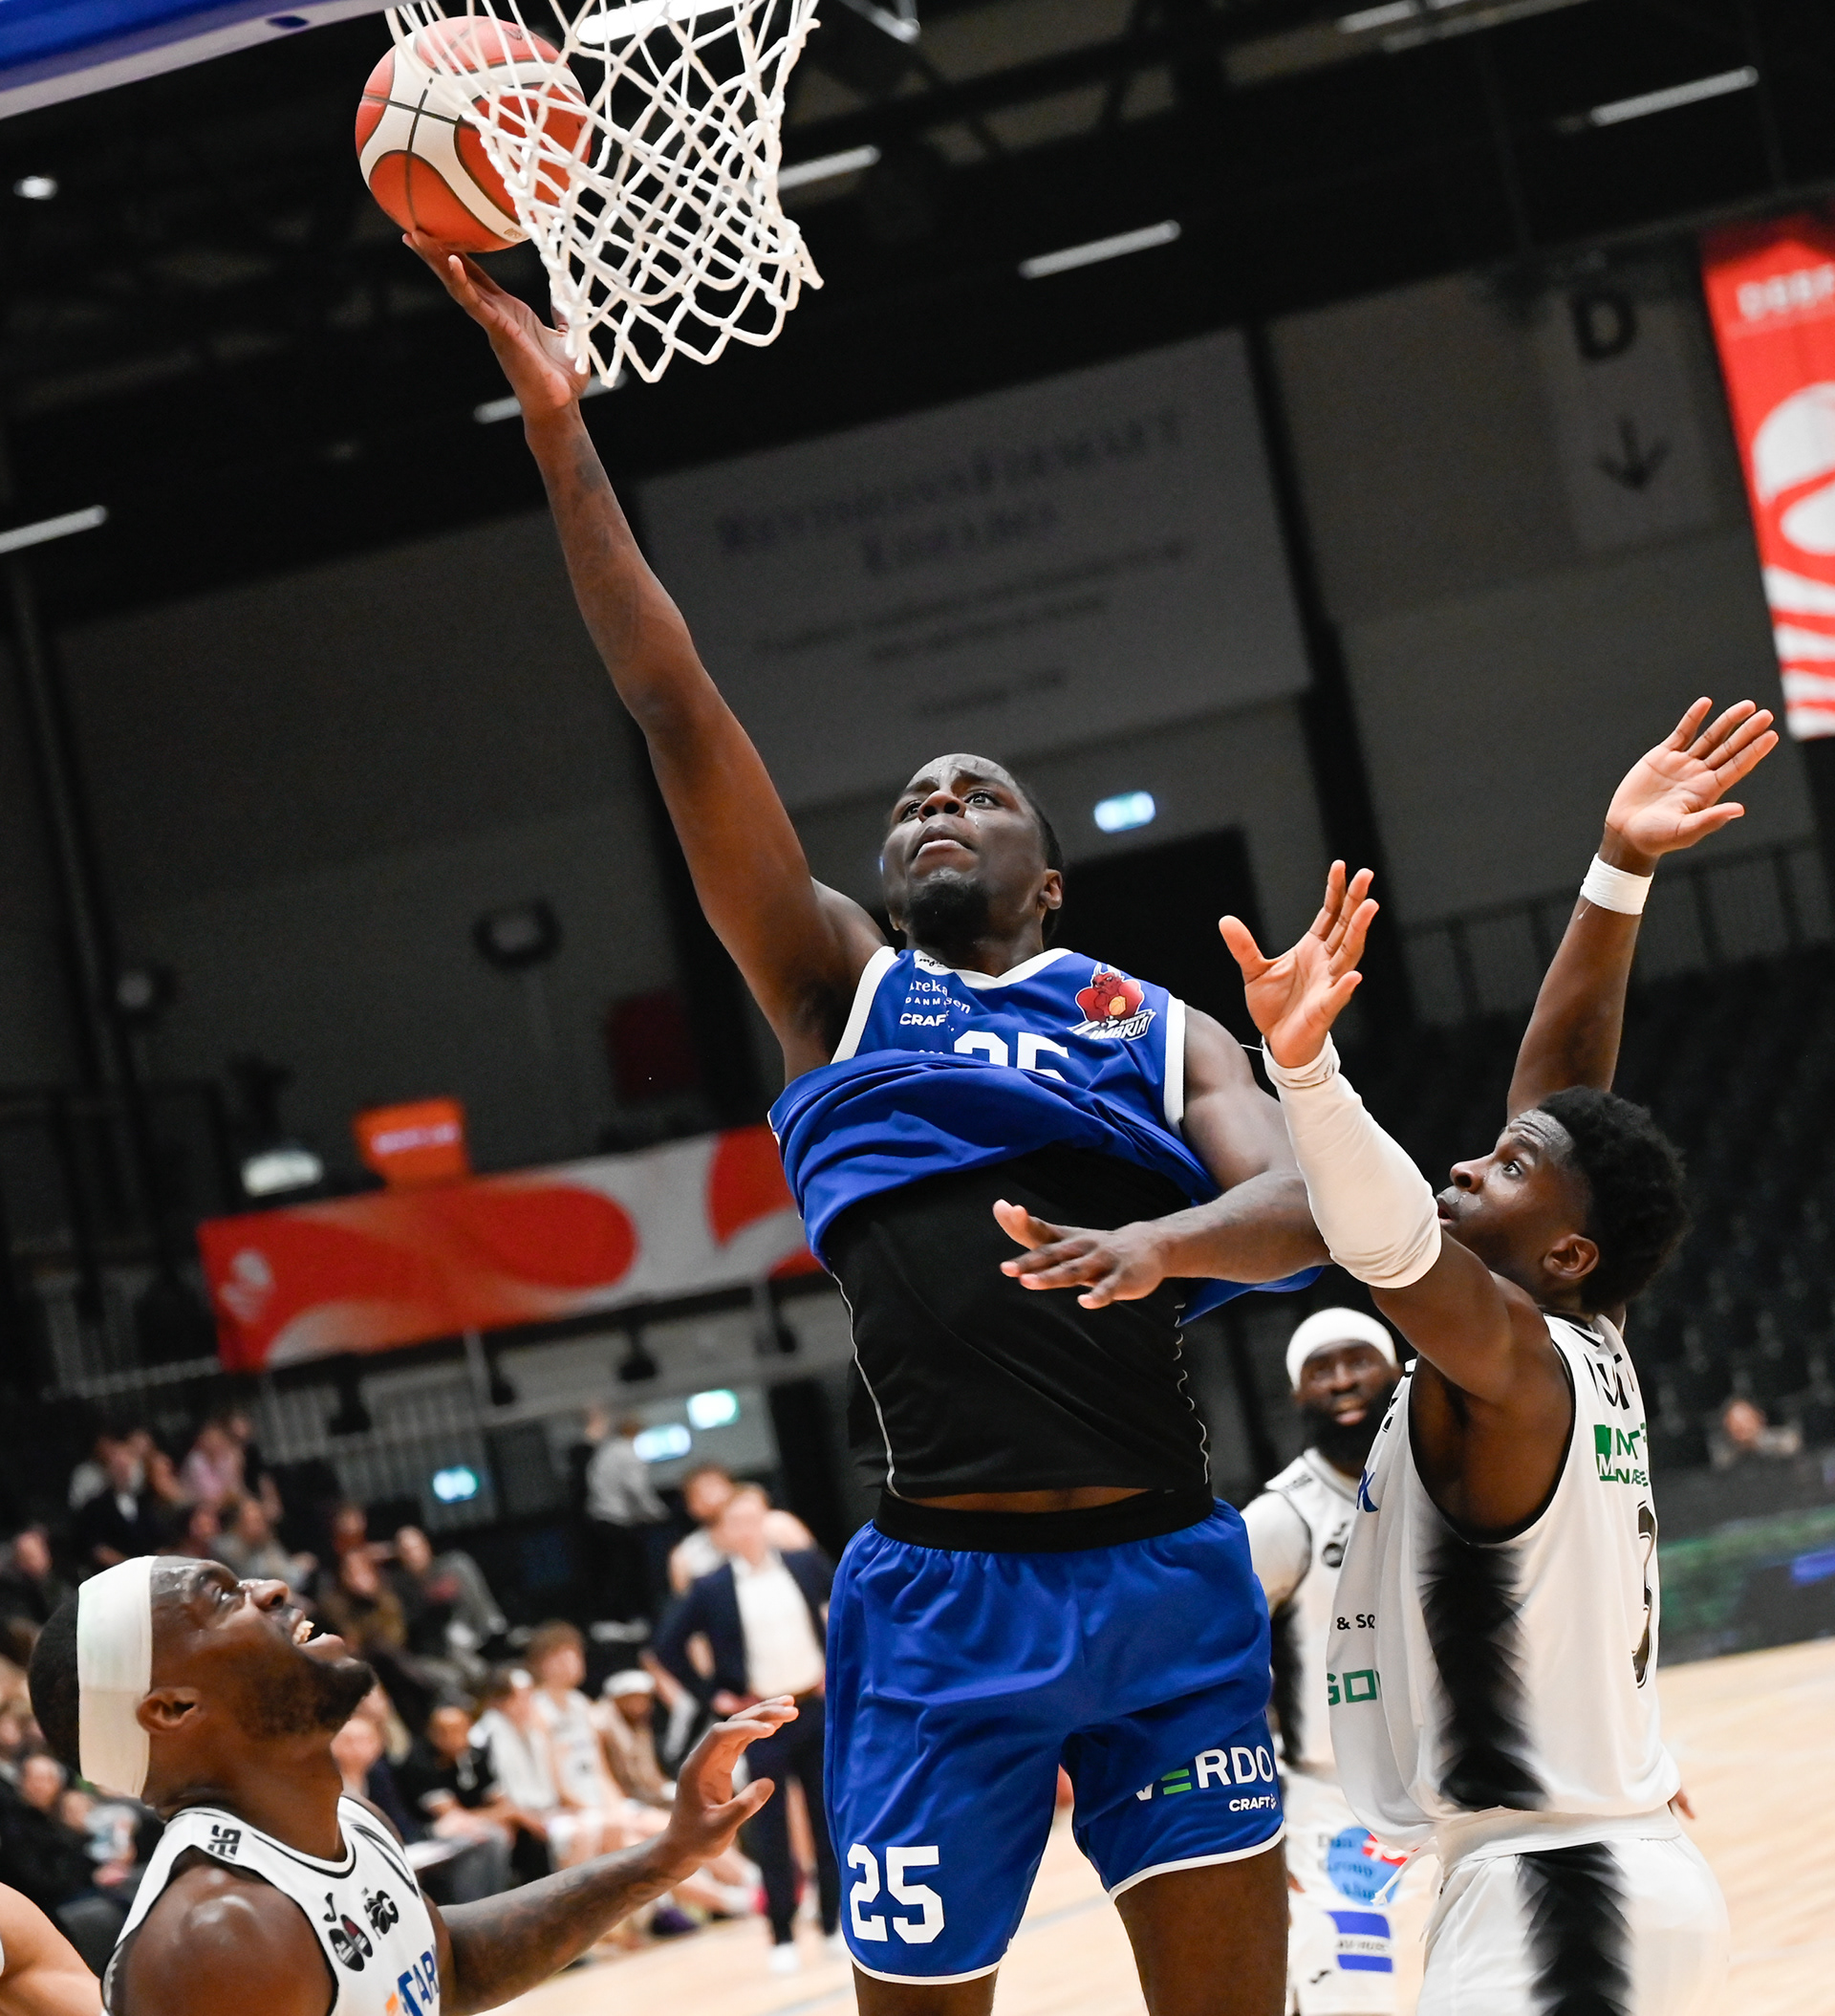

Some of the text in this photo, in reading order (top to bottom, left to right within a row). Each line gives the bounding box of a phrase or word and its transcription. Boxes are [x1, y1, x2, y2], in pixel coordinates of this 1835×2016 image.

[1574, 291, 1638, 360] D
[899, 1012, 950, 1027] CRAF
[1336, 1616, 1350, 1630] &
[1229, 1796, 1270, 1811] CRAFT
[847, 1843, 944, 1944] 25
